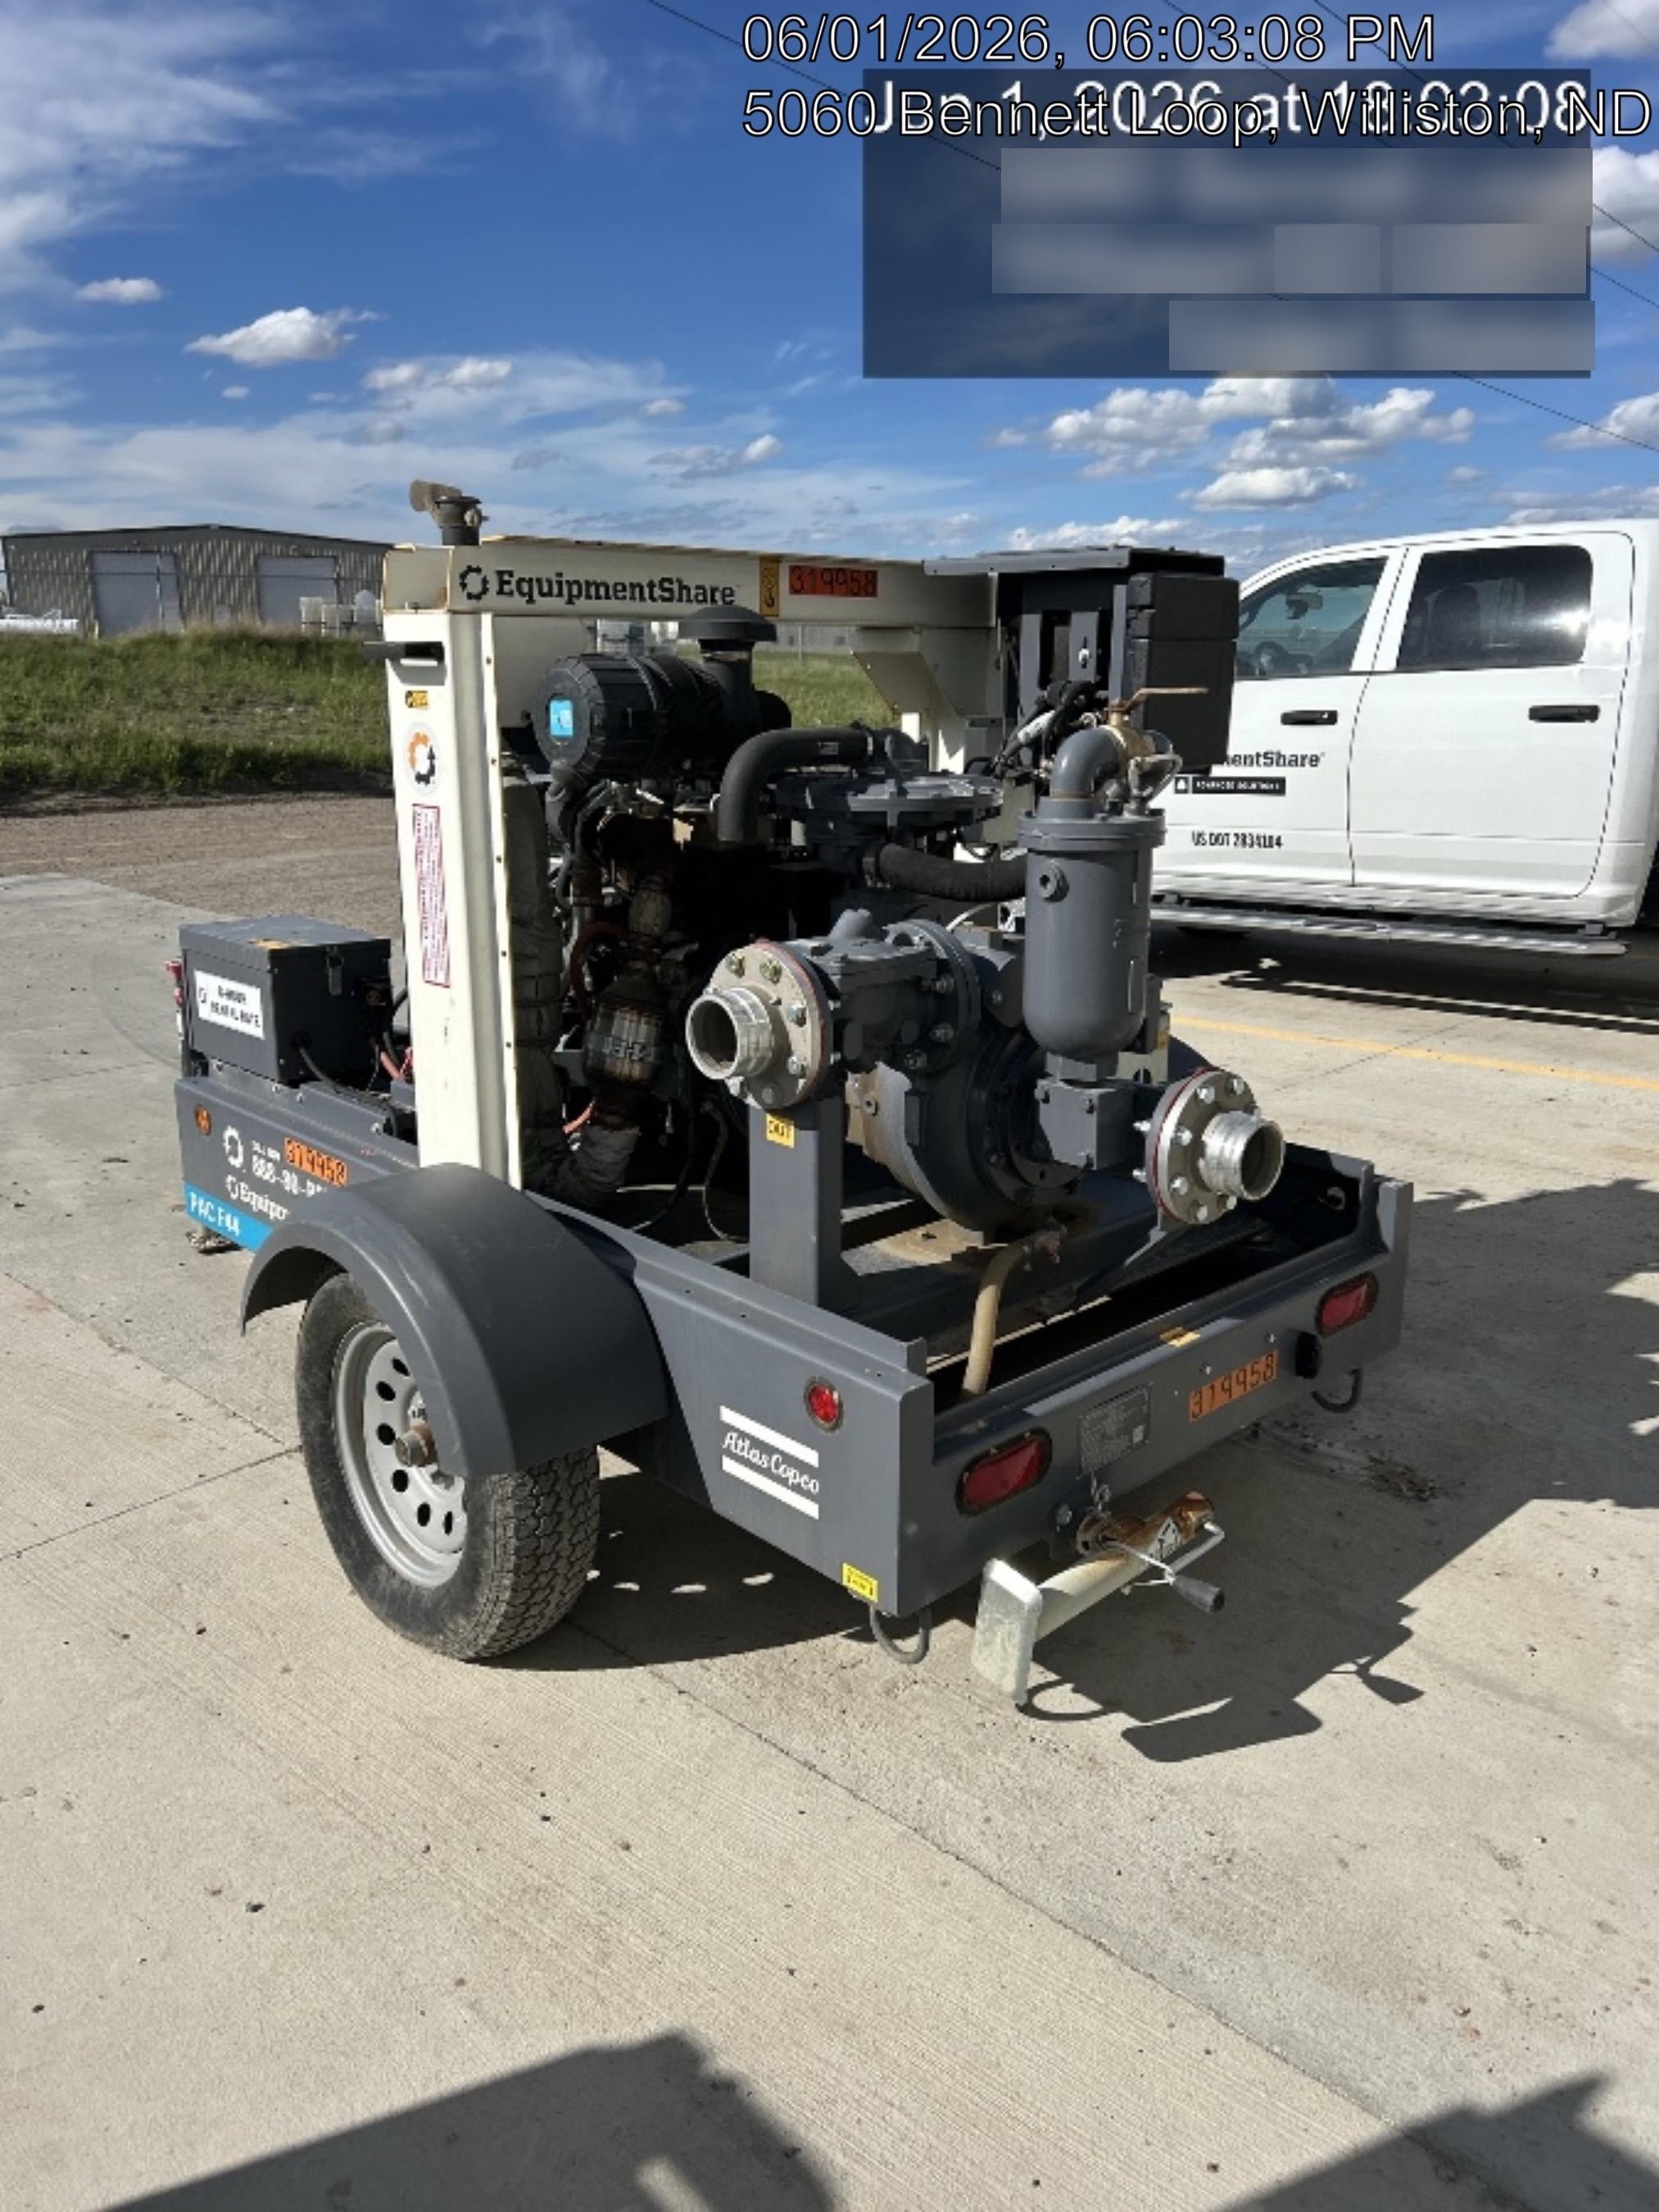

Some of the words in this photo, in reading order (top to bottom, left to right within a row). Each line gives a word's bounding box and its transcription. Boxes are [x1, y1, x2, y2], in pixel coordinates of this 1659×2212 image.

[495, 569, 737, 605] EquipmentShare
[790, 564, 877, 596] 319958
[1191, 830, 1208, 846] US
[1208, 832, 1231, 847] DOT
[190, 1192, 215, 1222] PAC
[217, 1206, 240, 1236] F44
[1192, 1353, 1275, 1420] 319958
[722, 1431, 769, 1469] Atlas
[771, 1454, 819, 1494] Copco
